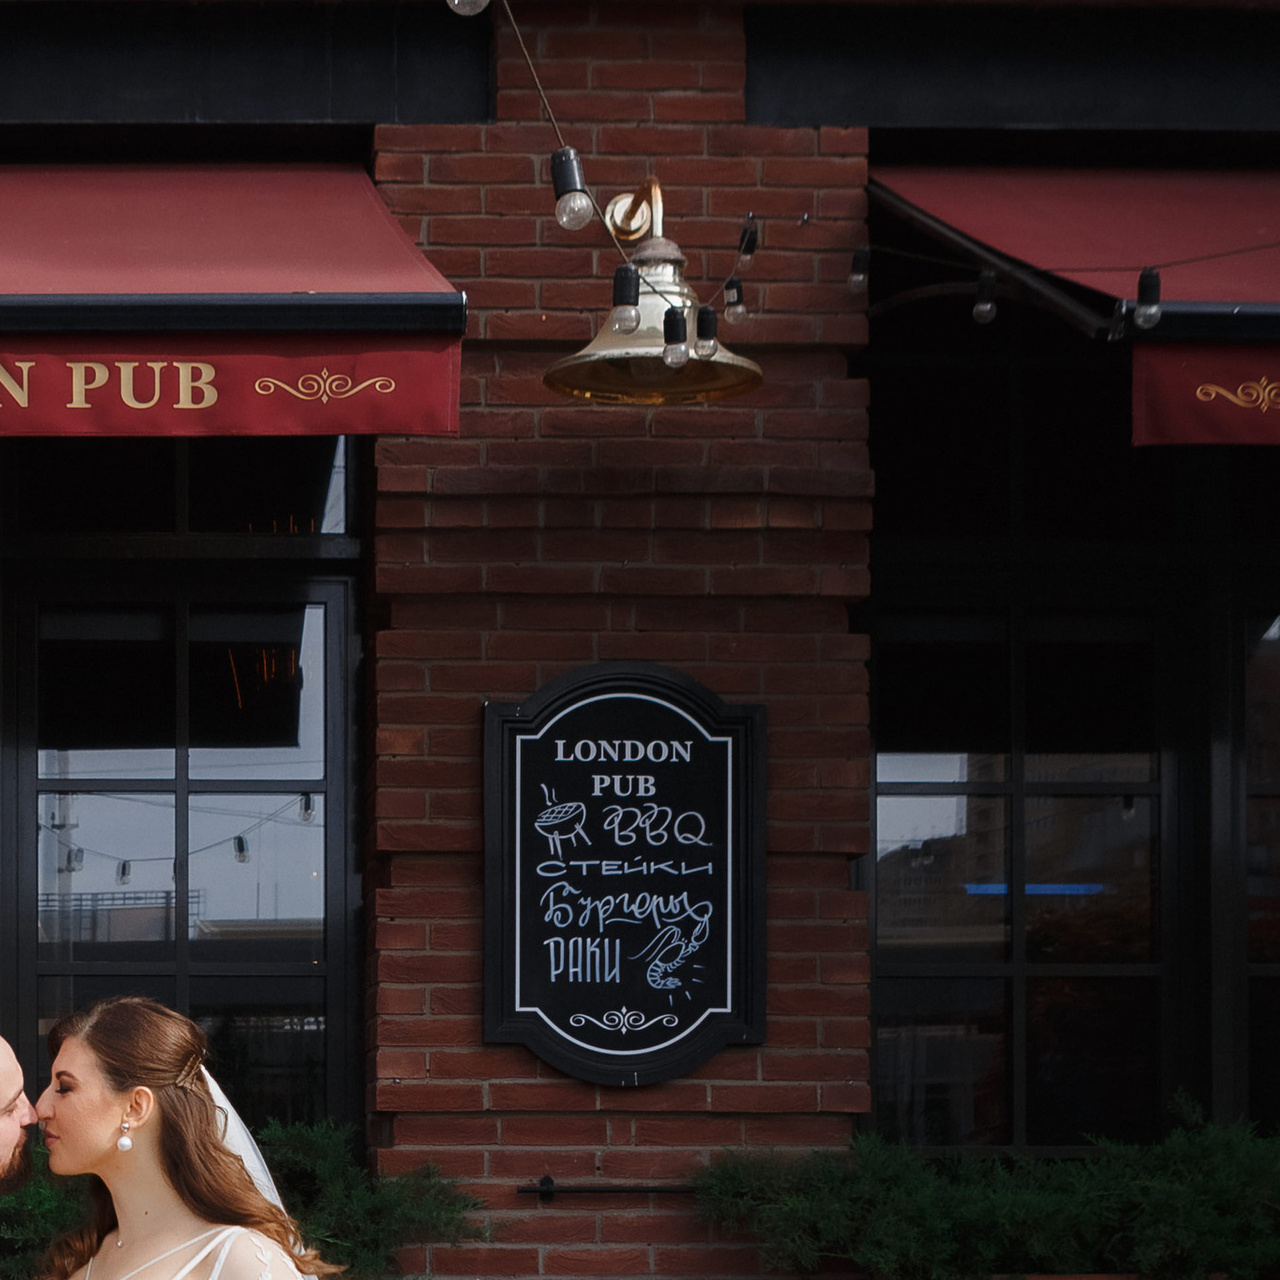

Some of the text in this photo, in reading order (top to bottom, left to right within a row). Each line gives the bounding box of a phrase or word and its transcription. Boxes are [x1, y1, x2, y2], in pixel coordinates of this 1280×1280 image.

[66, 361, 218, 410] PUB
[554, 739, 693, 763] LONDON
[591, 774, 657, 797] PUB
[602, 802, 713, 847] BBQ
[536, 855, 713, 876] СТЕЙКИ
[540, 881, 713, 933] Бургеры
[543, 937, 620, 983] РАКИ
